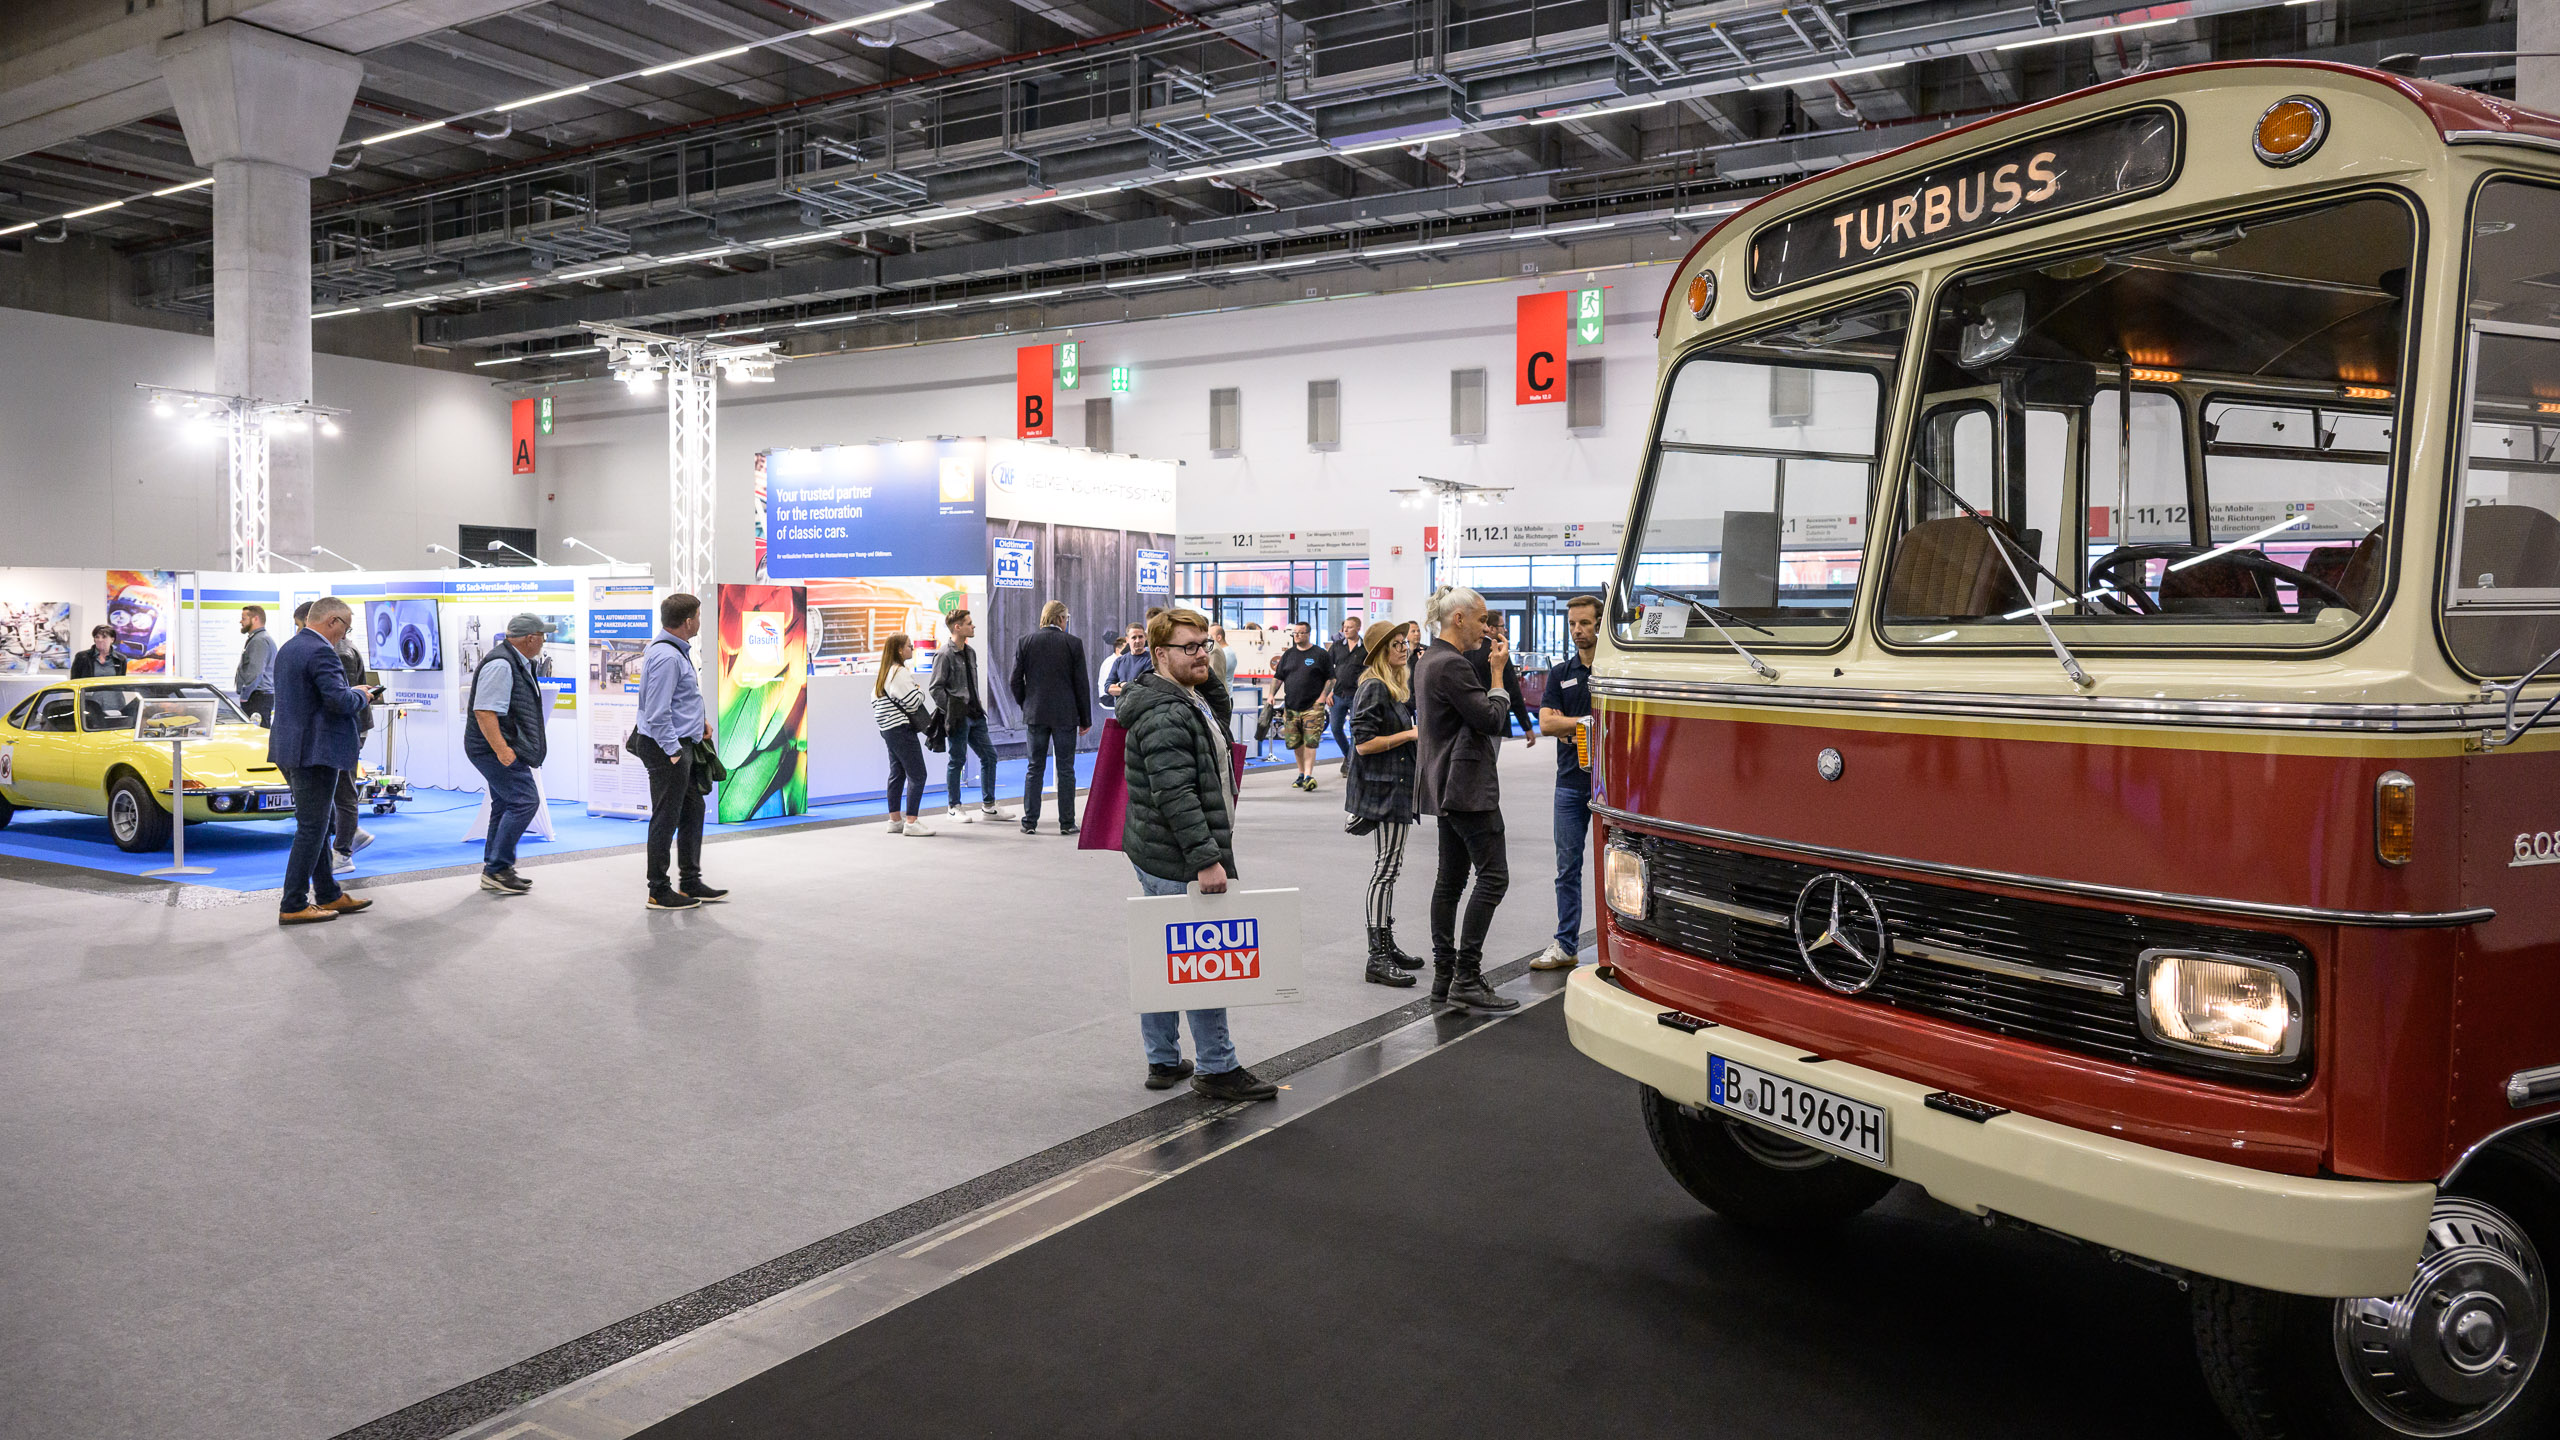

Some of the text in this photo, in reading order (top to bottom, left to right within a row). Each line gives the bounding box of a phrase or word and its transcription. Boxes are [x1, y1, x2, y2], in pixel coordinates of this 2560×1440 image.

[1833, 151, 2058, 259] TURBUSS
[1528, 352, 1554, 391] C
[1025, 394, 1044, 428] B
[516, 439, 530, 466] A
[1000, 466, 1015, 485] ZKF
[776, 486, 872, 503] Your trusted partner
[776, 504, 862, 521] for the restoration
[2227, 514, 2275, 523] Richtungen
[776, 525, 848, 540] of classic cars.
[1232, 534, 1253, 547] 12.1
[1484, 527, 1508, 540] 12.1
[456, 583, 466, 592] SVS
[995, 577, 1032, 587] Fachbetrieb
[1138, 585, 1169, 593] Fachbetrieb
[945, 600, 960, 609] FIV
[748, 634, 778, 645] Glasurit
[268, 796, 281, 807] WÜ
[1170, 921, 1254, 951] LIQUI
[1171, 951, 1257, 982] MOLY
[1715, 1085, 1721, 1095] D
[1726, 1066, 1742, 1104] B
